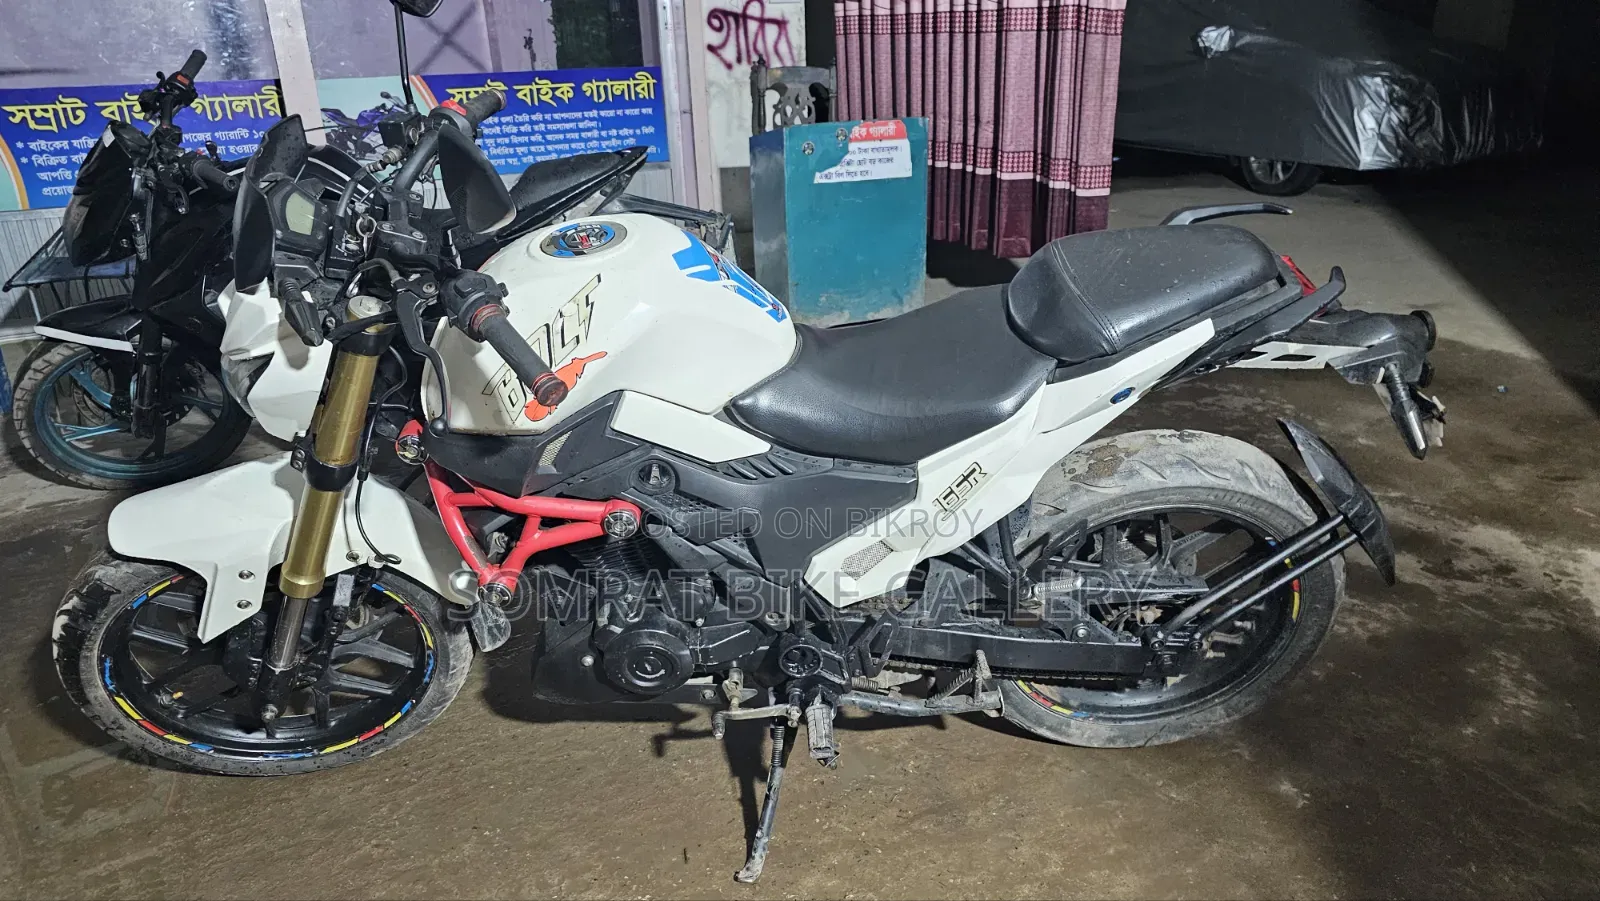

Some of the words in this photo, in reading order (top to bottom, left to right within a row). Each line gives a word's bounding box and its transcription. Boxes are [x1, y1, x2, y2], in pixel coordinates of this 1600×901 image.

[512, 76, 575, 107] বাইক
[581, 70, 657, 103] গ্যালারী
[2, 94, 88, 133] সম্রাট
[94, 91, 146, 124] বাই
[190, 85, 283, 123] গ্যালারী
[27, 138, 70, 152] বাইকের
